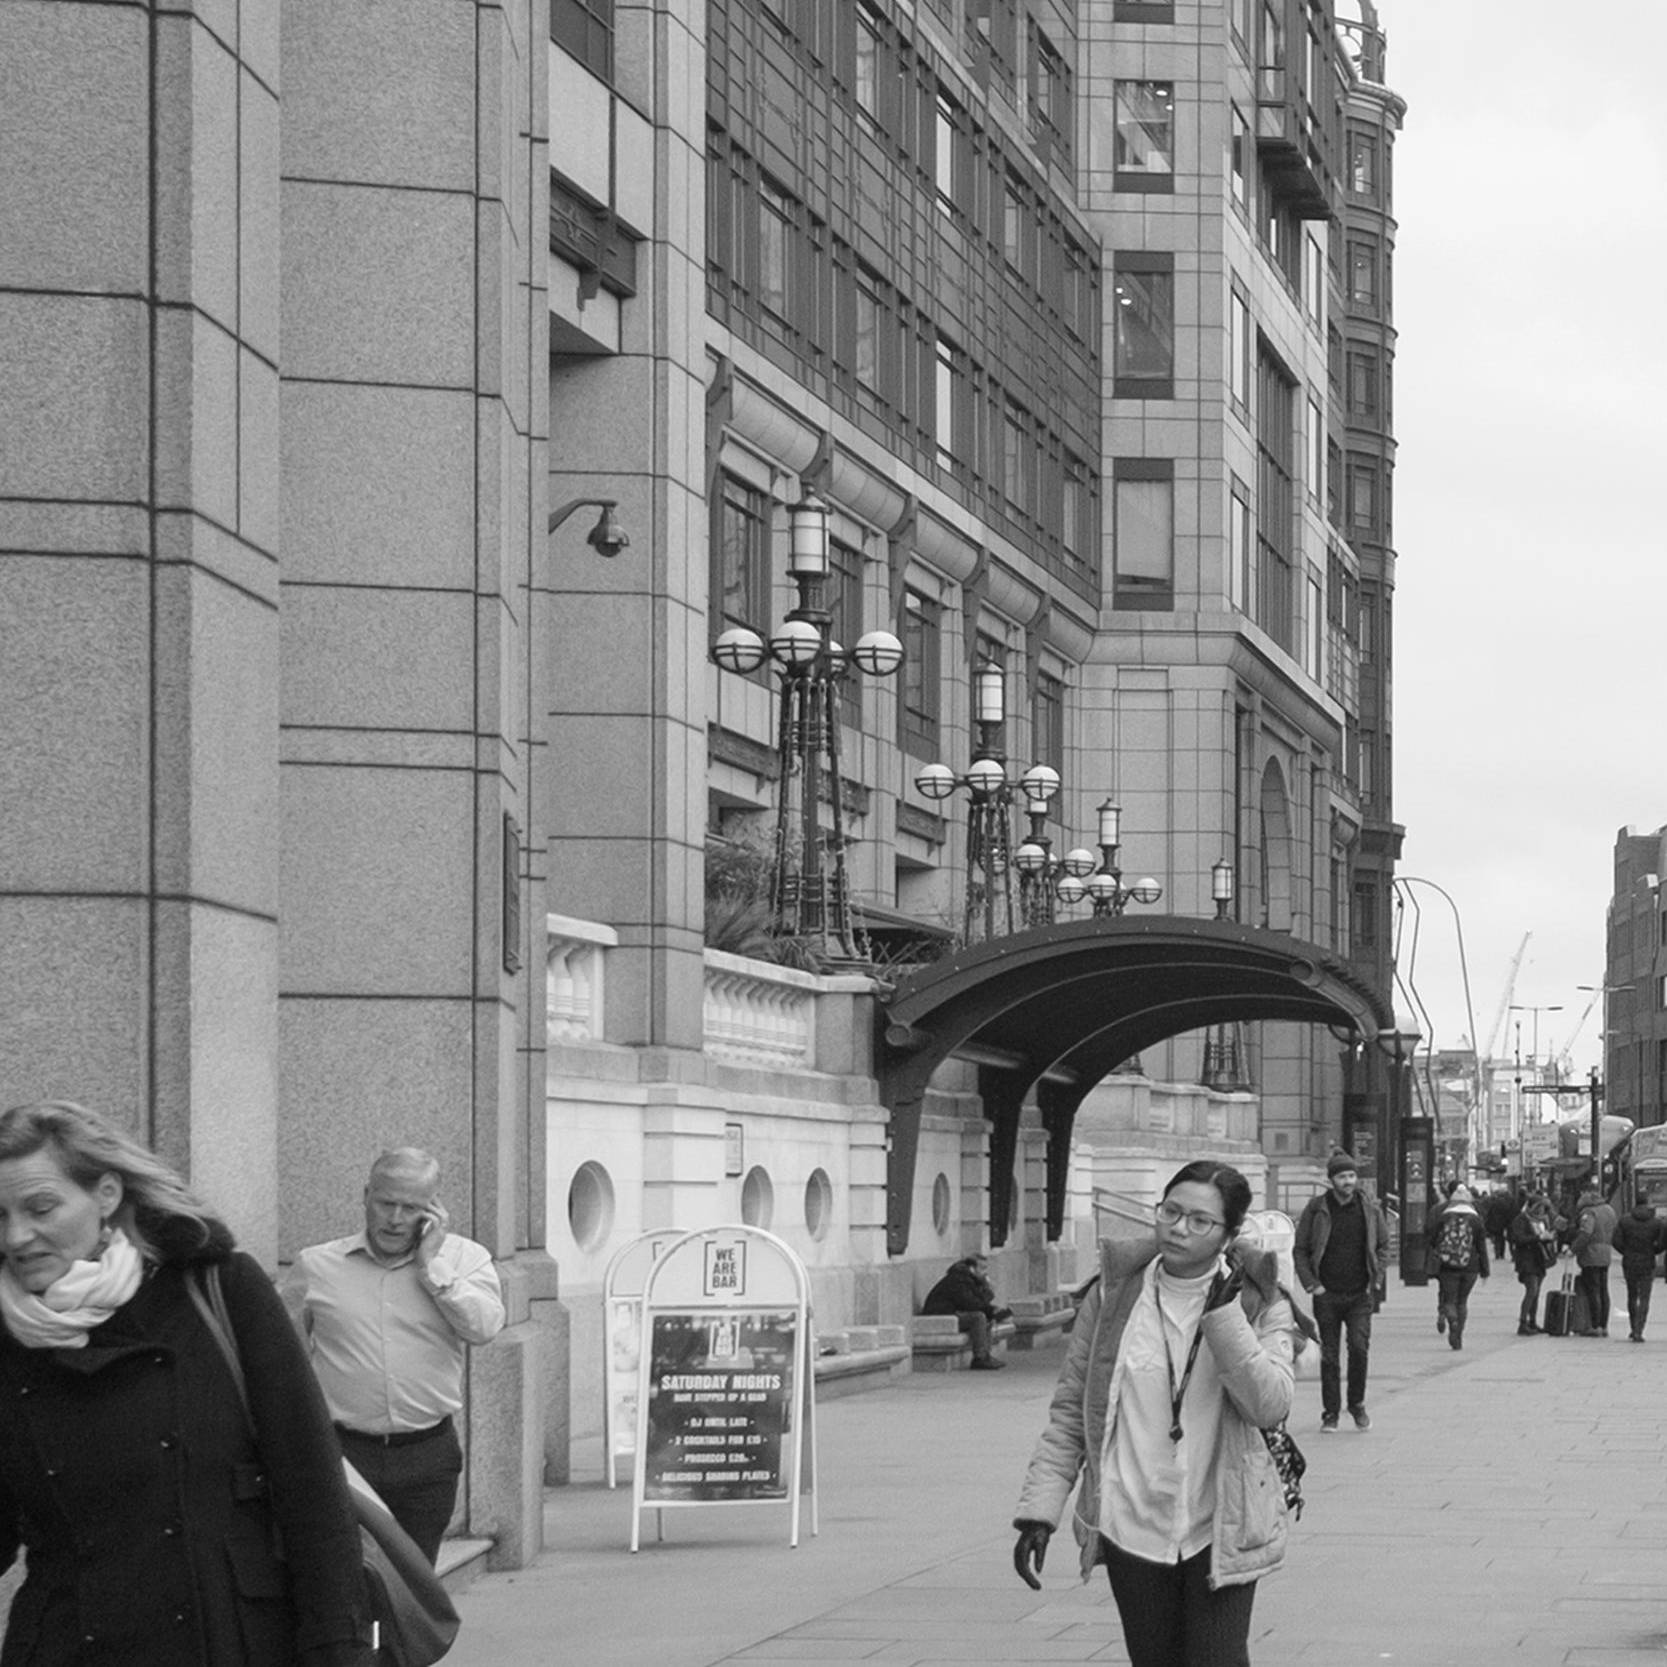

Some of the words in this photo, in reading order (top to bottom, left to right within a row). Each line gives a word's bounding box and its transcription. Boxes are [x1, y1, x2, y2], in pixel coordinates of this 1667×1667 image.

[716, 1248, 735, 1261] WE
[713, 1262, 737, 1274] ARE
[712, 1276, 737, 1288] BAR
[661, 1375, 727, 1390] SATURDAY
[732, 1374, 781, 1390] NIGHTS
